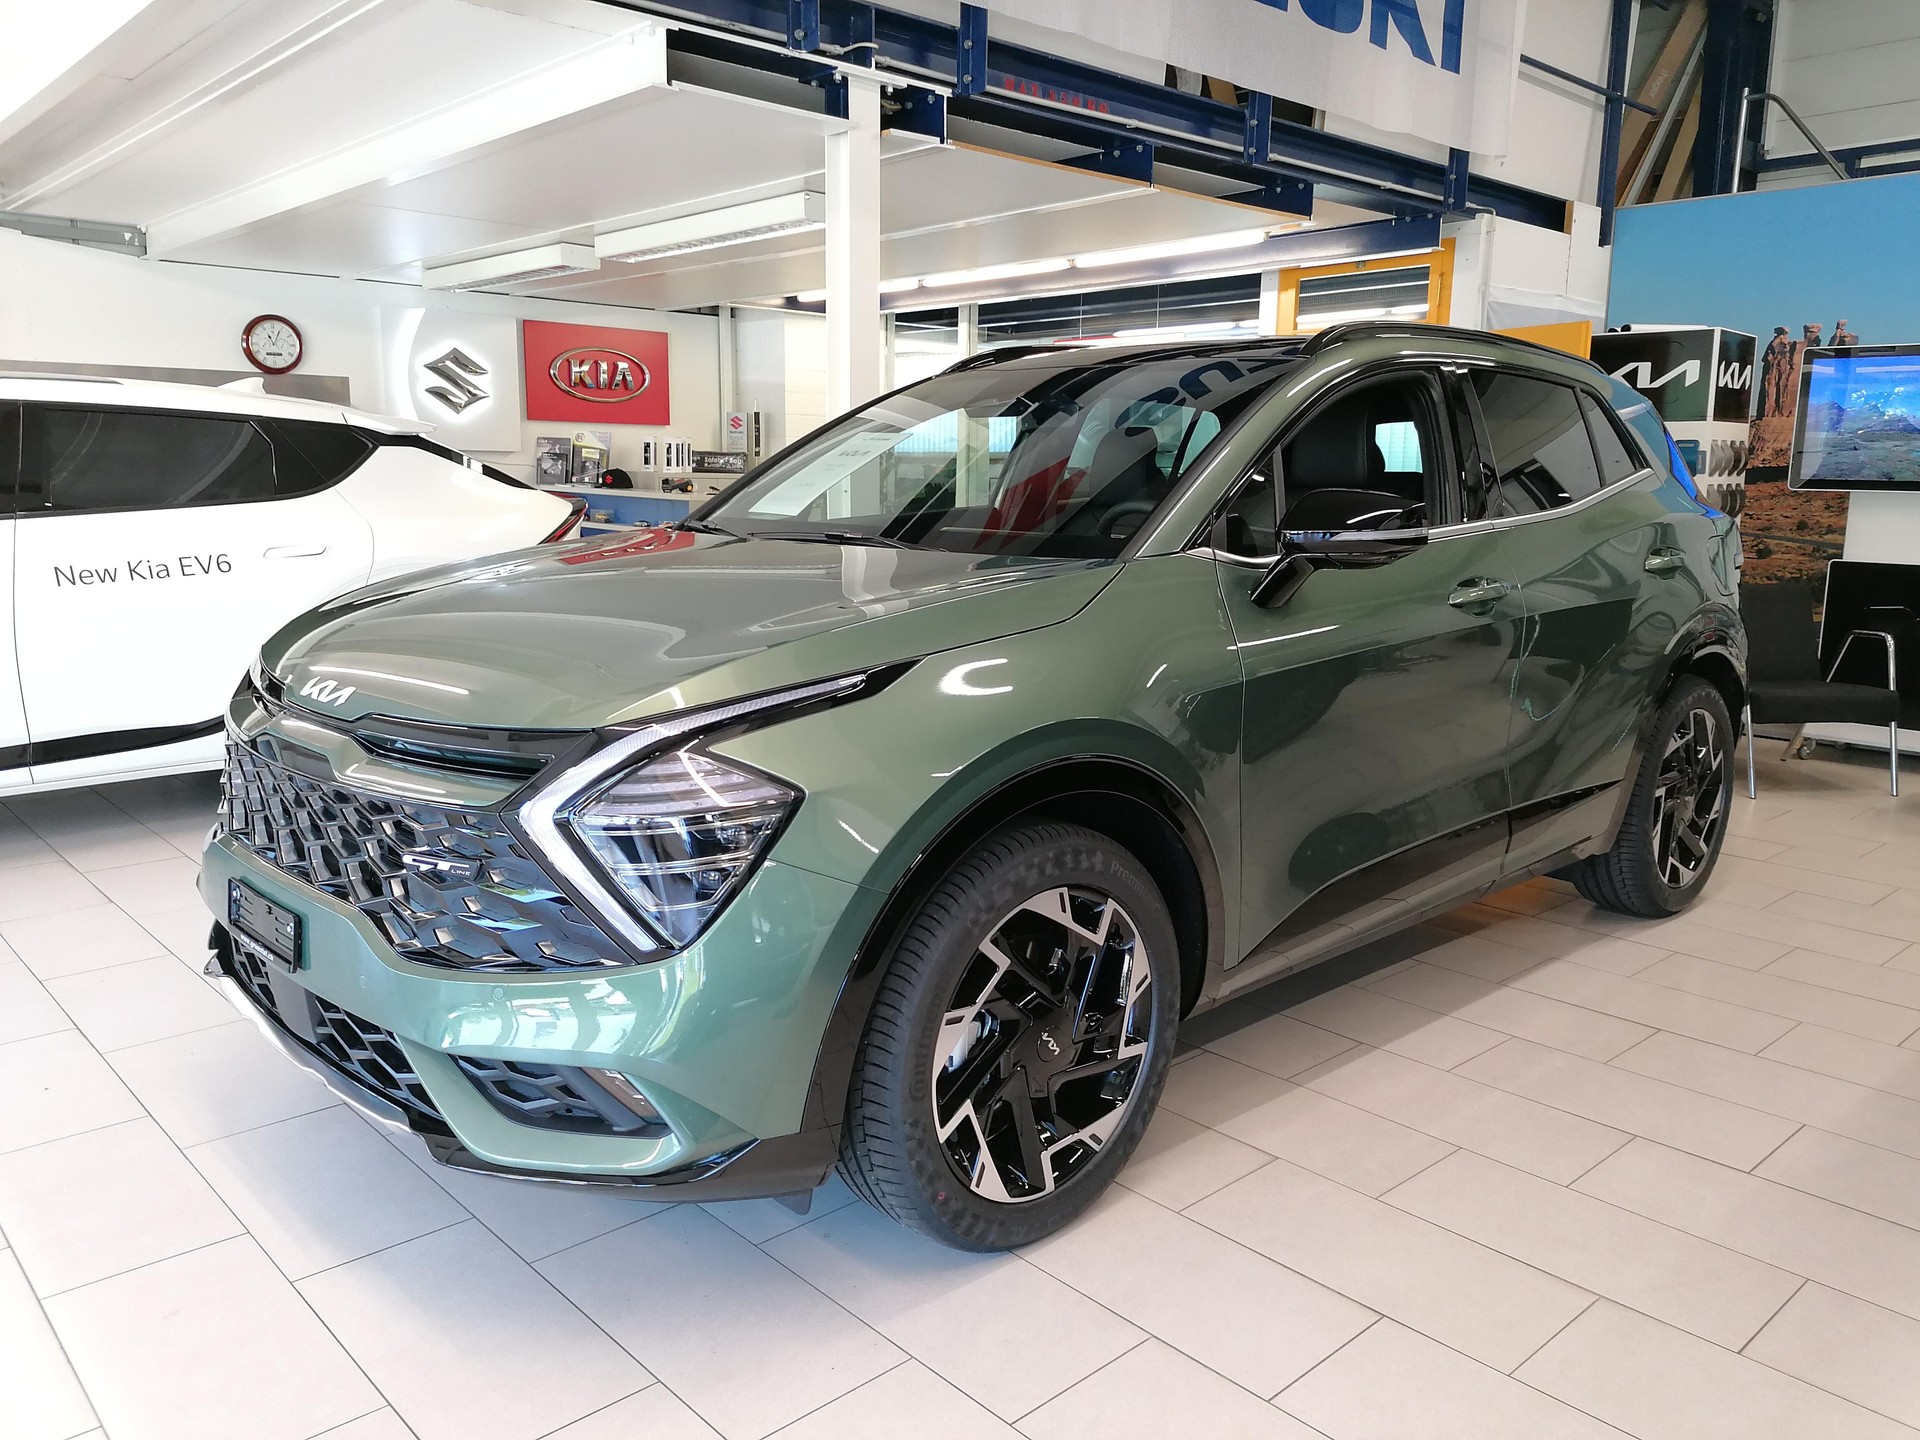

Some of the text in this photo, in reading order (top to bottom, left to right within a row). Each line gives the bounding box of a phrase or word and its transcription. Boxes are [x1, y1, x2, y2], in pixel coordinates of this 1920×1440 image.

[566, 358, 635, 391] KIA
[54, 553, 232, 587] New Kia EV6
[299, 675, 357, 707] KIA
[451, 868, 472, 876] LINE
